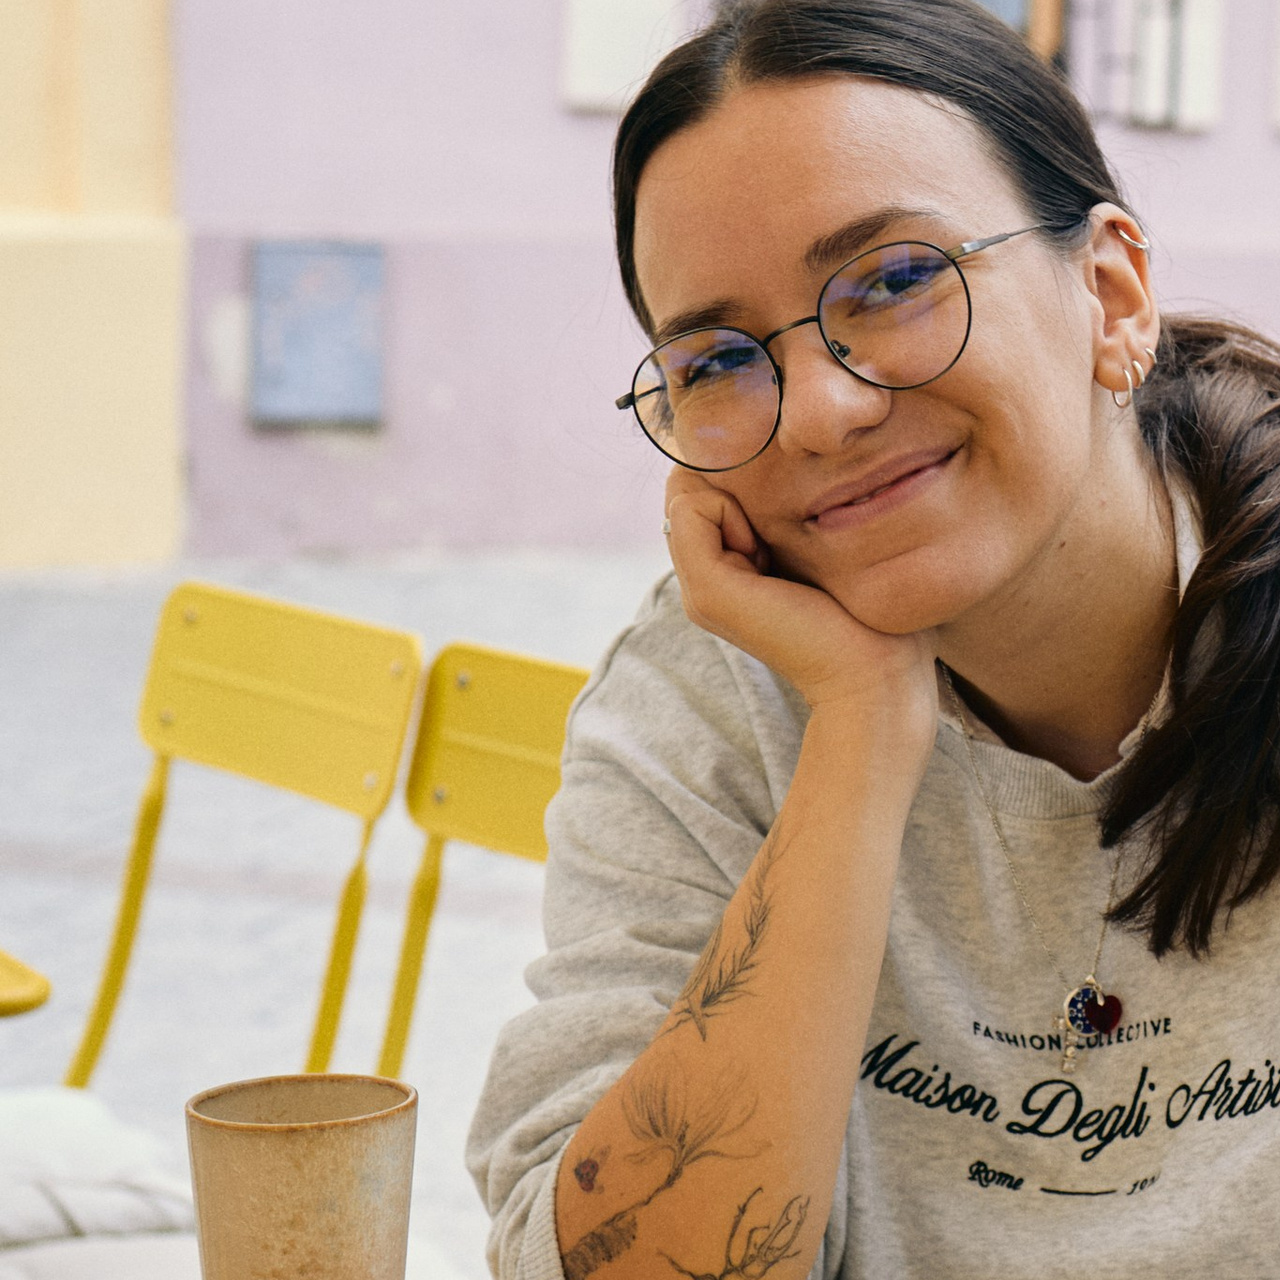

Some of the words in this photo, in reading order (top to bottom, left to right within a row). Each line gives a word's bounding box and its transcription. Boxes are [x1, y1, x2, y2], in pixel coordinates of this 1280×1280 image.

[973, 1020, 1062, 1051] FASHION
[860, 1033, 1000, 1122] Maison
[1006, 1066, 1155, 1161] Degli
[968, 1160, 1024, 1191] Rome
